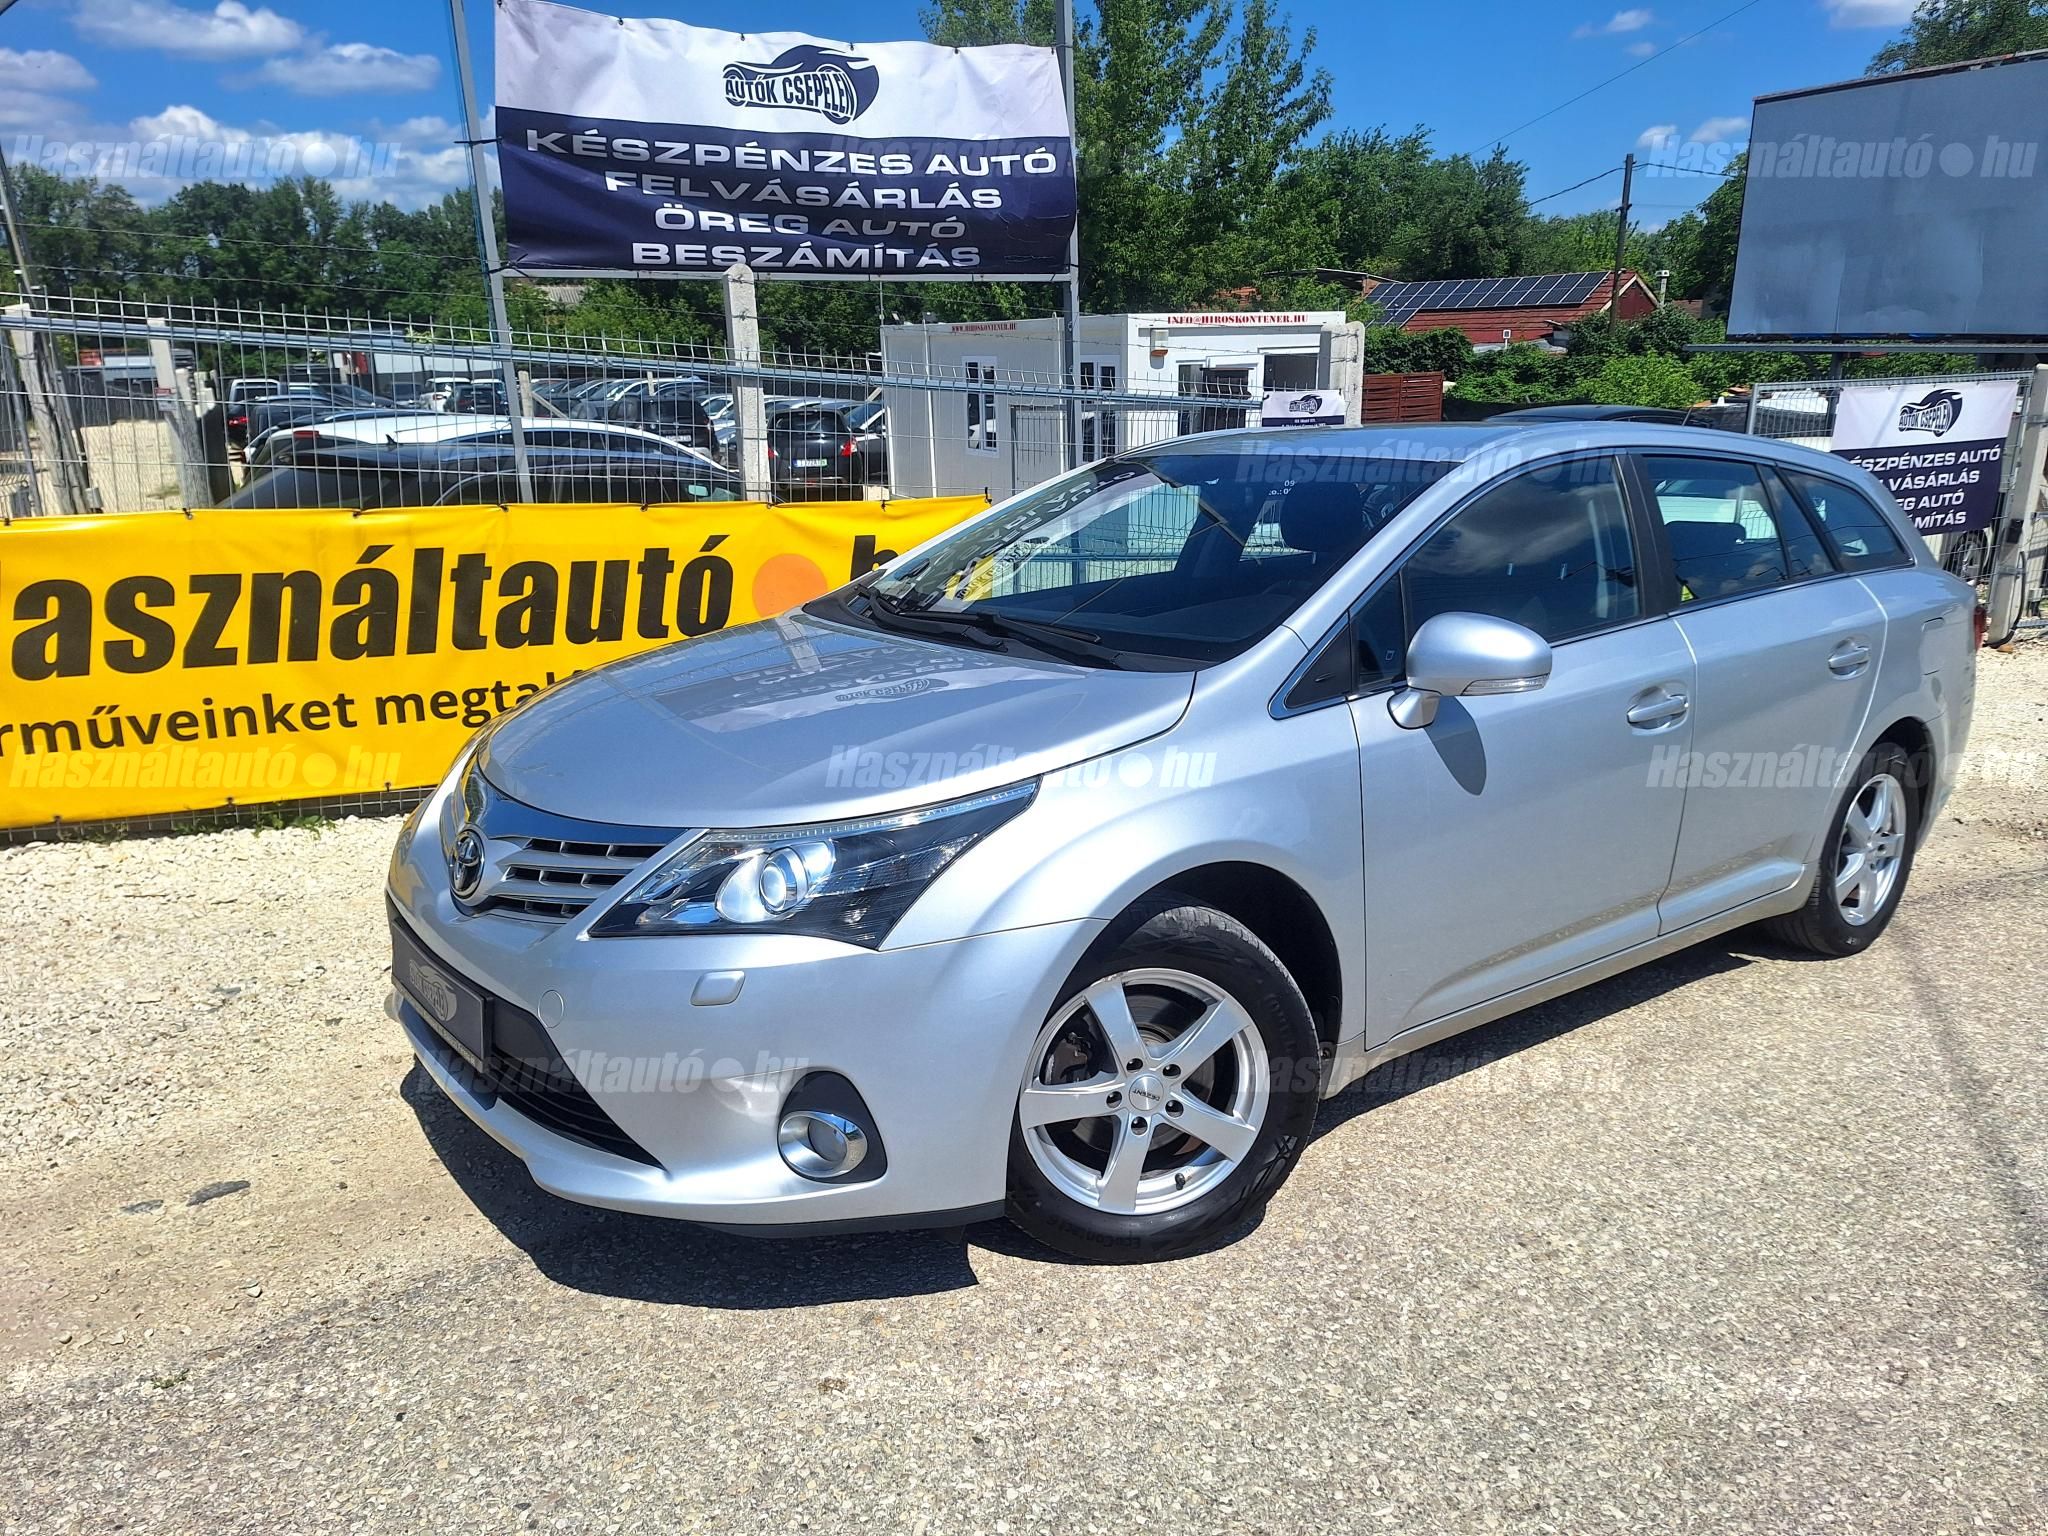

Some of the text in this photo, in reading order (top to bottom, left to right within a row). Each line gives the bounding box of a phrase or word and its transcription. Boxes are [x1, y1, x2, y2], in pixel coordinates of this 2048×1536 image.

[725, 73, 855, 116] AUTÓK CSEPELEN
[526, 129, 1057, 176] KÉSZPÉNZES AUTÓ
[604, 170, 1003, 210] FELVÁSÁRLÁS
[654, 202, 967, 238] ÖREG AUTÓ
[632, 241, 981, 268] BESZÁMÍTÁS
[1167, 314, 1309, 325] INFO@HIROSKONTENER.HU
[1850, 444, 2001, 472] ÉSZPÉNZES AUTÓ
[1882, 467, 1981, 492] VÁSÁRLÁS
[1917, 488, 1965, 509] AUTÓ
[1911, 509, 1967, 529] MÍTÁS
[10, 534, 734, 682] asználtautó
[0, 690, 359, 758] rműveinket
